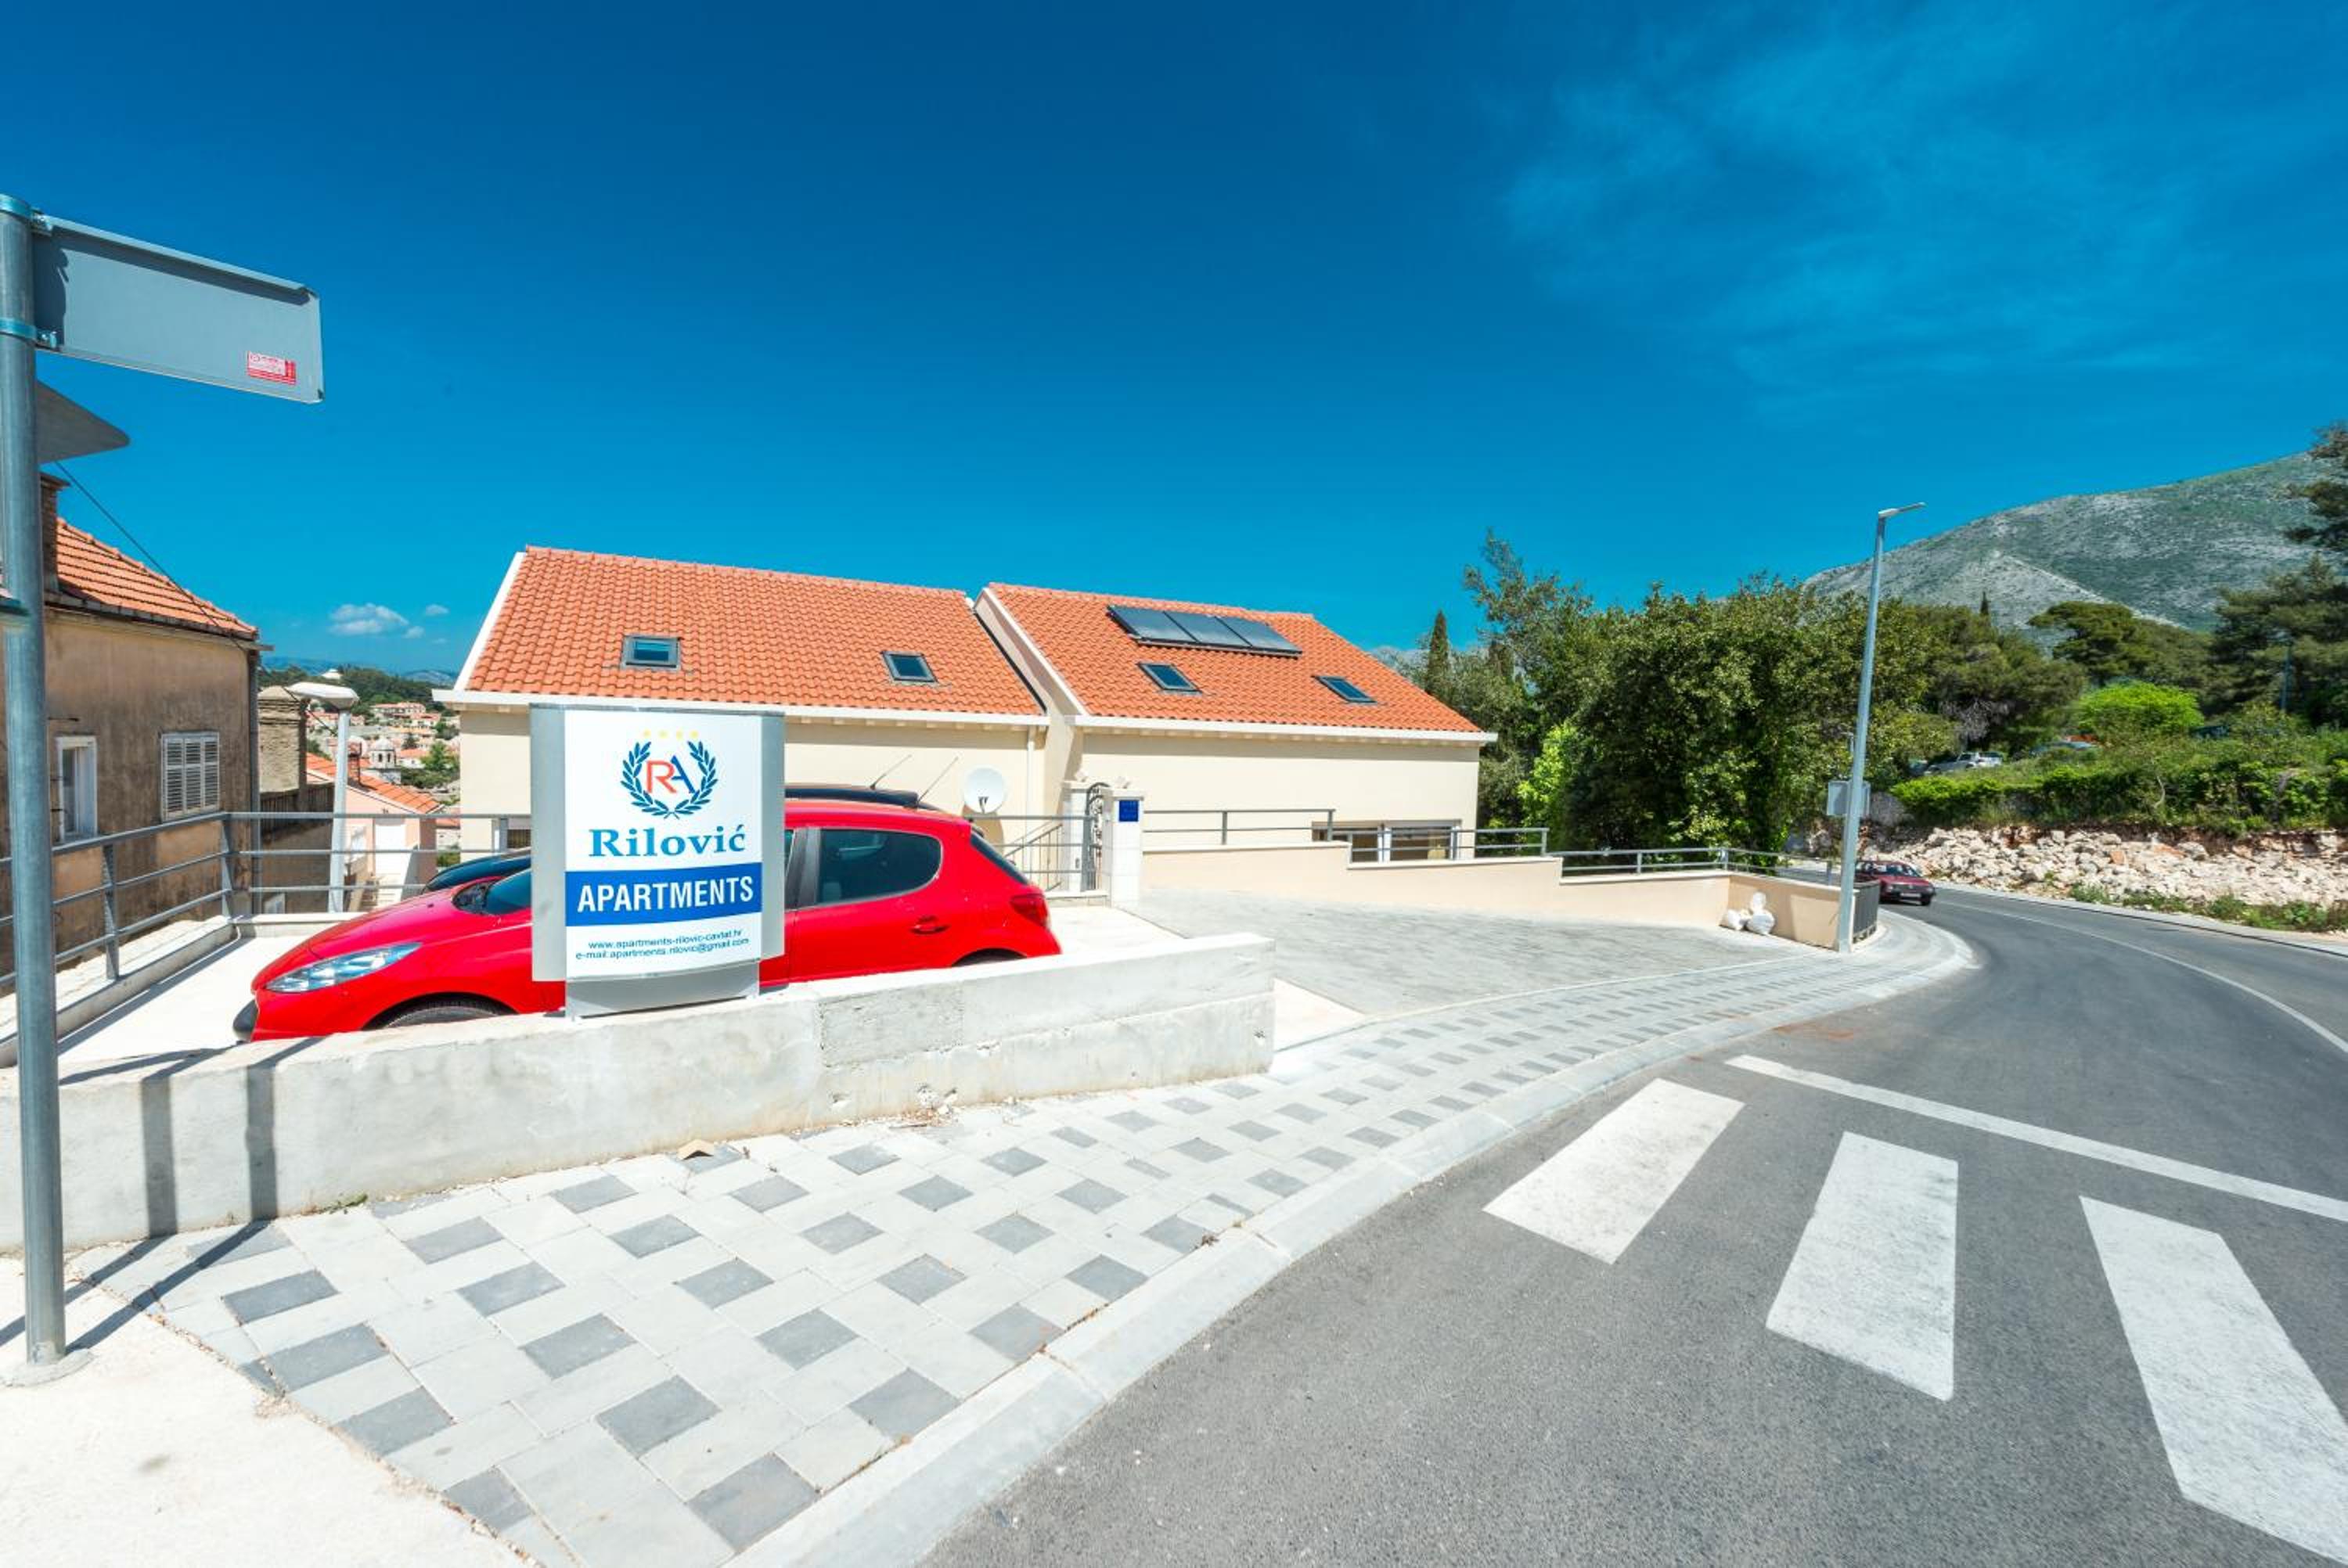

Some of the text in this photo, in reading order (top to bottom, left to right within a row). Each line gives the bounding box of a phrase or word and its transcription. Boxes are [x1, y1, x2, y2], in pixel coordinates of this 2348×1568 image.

[646, 755, 695, 794] RA
[589, 824, 746, 857] Rilović
[577, 876, 754, 912] APARTMENTS
